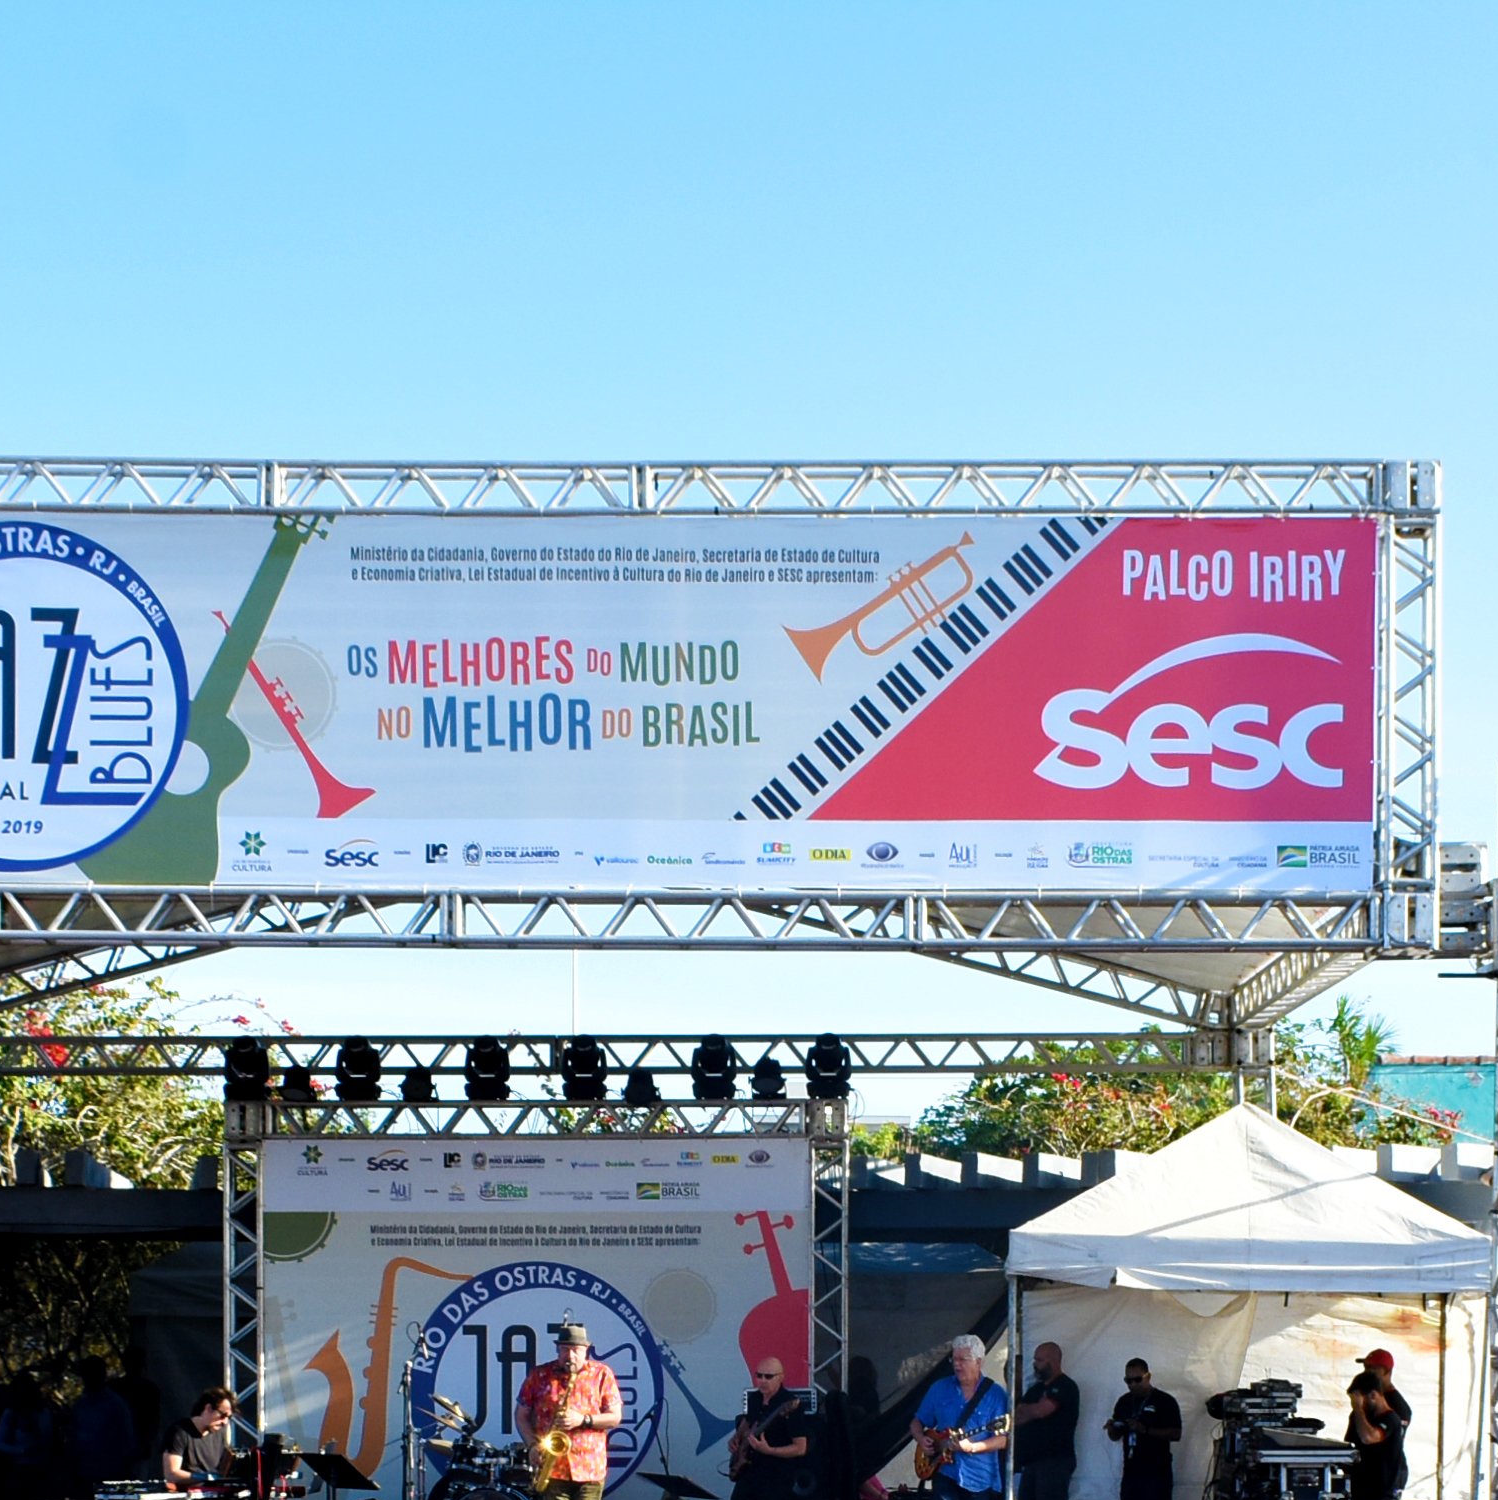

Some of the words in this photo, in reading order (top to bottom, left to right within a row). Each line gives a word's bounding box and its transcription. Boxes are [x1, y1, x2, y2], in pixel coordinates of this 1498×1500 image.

[350, 546, 408, 562] Ministério
[411, 547, 425, 562] da
[427, 546, 488, 564] Cidadania,
[491, 547, 537, 562] Governo
[539, 547, 554, 562] do
[557, 547, 595, 562] Estado
[597, 547, 612, 562] do
[615, 547, 633, 562] Rio
[635, 547, 649, 562] de
[652, 547, 700, 564] Janeiro,
[702, 548, 761, 563] Secretaria
[764, 548, 778, 563] de
[781, 548, 819, 563] Estado
[821, 549, 835, 563] de
[838, 548, 880, 564] Cultura
[351, 569, 359, 581] e
[361, 567, 416, 582] Economia
[418, 567, 466, 583] Criativa,
[468, 567, 485, 582] Lei
[487, 567, 536, 582] Estadual
[539, 567, 553, 582] de
[556, 567, 610, 582] Incentivo
[613, 566, 620, 582] à
[622, 567, 665, 582] Cultura
[668, 568, 682, 582] do
[684, 568, 702, 582] Rio
[704, 568, 719, 583] de
[722, 568, 765, 583] Janeiro
[768, 571, 775, 583] e
[777, 568, 803, 583] SESC
[805, 568, 878, 585] apresentam:
[1122, 549, 1234, 601] PALCO
[1249, 549, 1346, 602] IRIRY
[89, 550, 118, 576] RJ
[127, 581, 166, 628] BRASIL
[347, 644, 379, 678] OS
[388, 636, 574, 688] MELHORES
[586, 647, 611, 677] DO
[619, 640, 739, 687] MUNDO
[89, 635, 154, 785] BLUES
[377, 705, 412, 741] NO
[422, 692, 591, 753] MELHOR
[601, 707, 632, 739] DO
[641, 700, 761, 748] BRASIL
[1, 819, 44, 835] 2019
[484, 850, 502, 858] RIO
[504, 850, 517, 858] DE
[518, 850, 560, 858] JANEIRO
[1092, 846, 1115, 857] RIO
[1115, 849, 1133, 857] DAS
[1309, 844, 1333, 852] PÁTRIA
[1092, 856, 1133, 865] OSTRAS
[1309, 852, 1360, 865] BRASIL
[661, 1187, 700, 1197] BRASIL
[370, 1224, 407, 1234] Ministério
[408, 1225, 418, 1234] da
[419, 1224, 457, 1236] Cidadania,
[458, 1225, 487, 1234] Governo
[489, 1225, 498, 1234] do
[500, 1225, 524, 1234] Estado
[525, 1225, 534, 1234] do
[535, 1225, 547, 1234] Rio
[548, 1225, 557, 1234] de
[559, 1225, 589, 1236] Janeiro,
[590, 1224, 628, 1234] Secretaria
[629, 1225, 638, 1234] de
[639, 1225, 663, 1234] Estado
[664, 1225, 674, 1234] de
[675, 1225, 702, 1234] Cultura
[377, 1237, 412, 1246] Economia
[413, 1237, 444, 1248] Criativa,
[445, 1237, 455, 1246] Lei
[456, 1237, 487, 1246] Estadual
[489, 1237, 498, 1246] de
[499, 1237, 533, 1246] Incentivo
[540, 1237, 567, 1246] Cultura
[568, 1237, 577, 1246] do
[579, 1237, 590, 1246] Rio
[591, 1237, 601, 1246] de
[602, 1237, 629, 1246] Janeiro
[637, 1237, 653, 1246] SESC
[442, 1280, 490, 1324] DAS
[494, 1265, 577, 1289] OSTRAS
[590, 1281, 612, 1300] RJ
[617, 1303, 647, 1337] BRASIL
